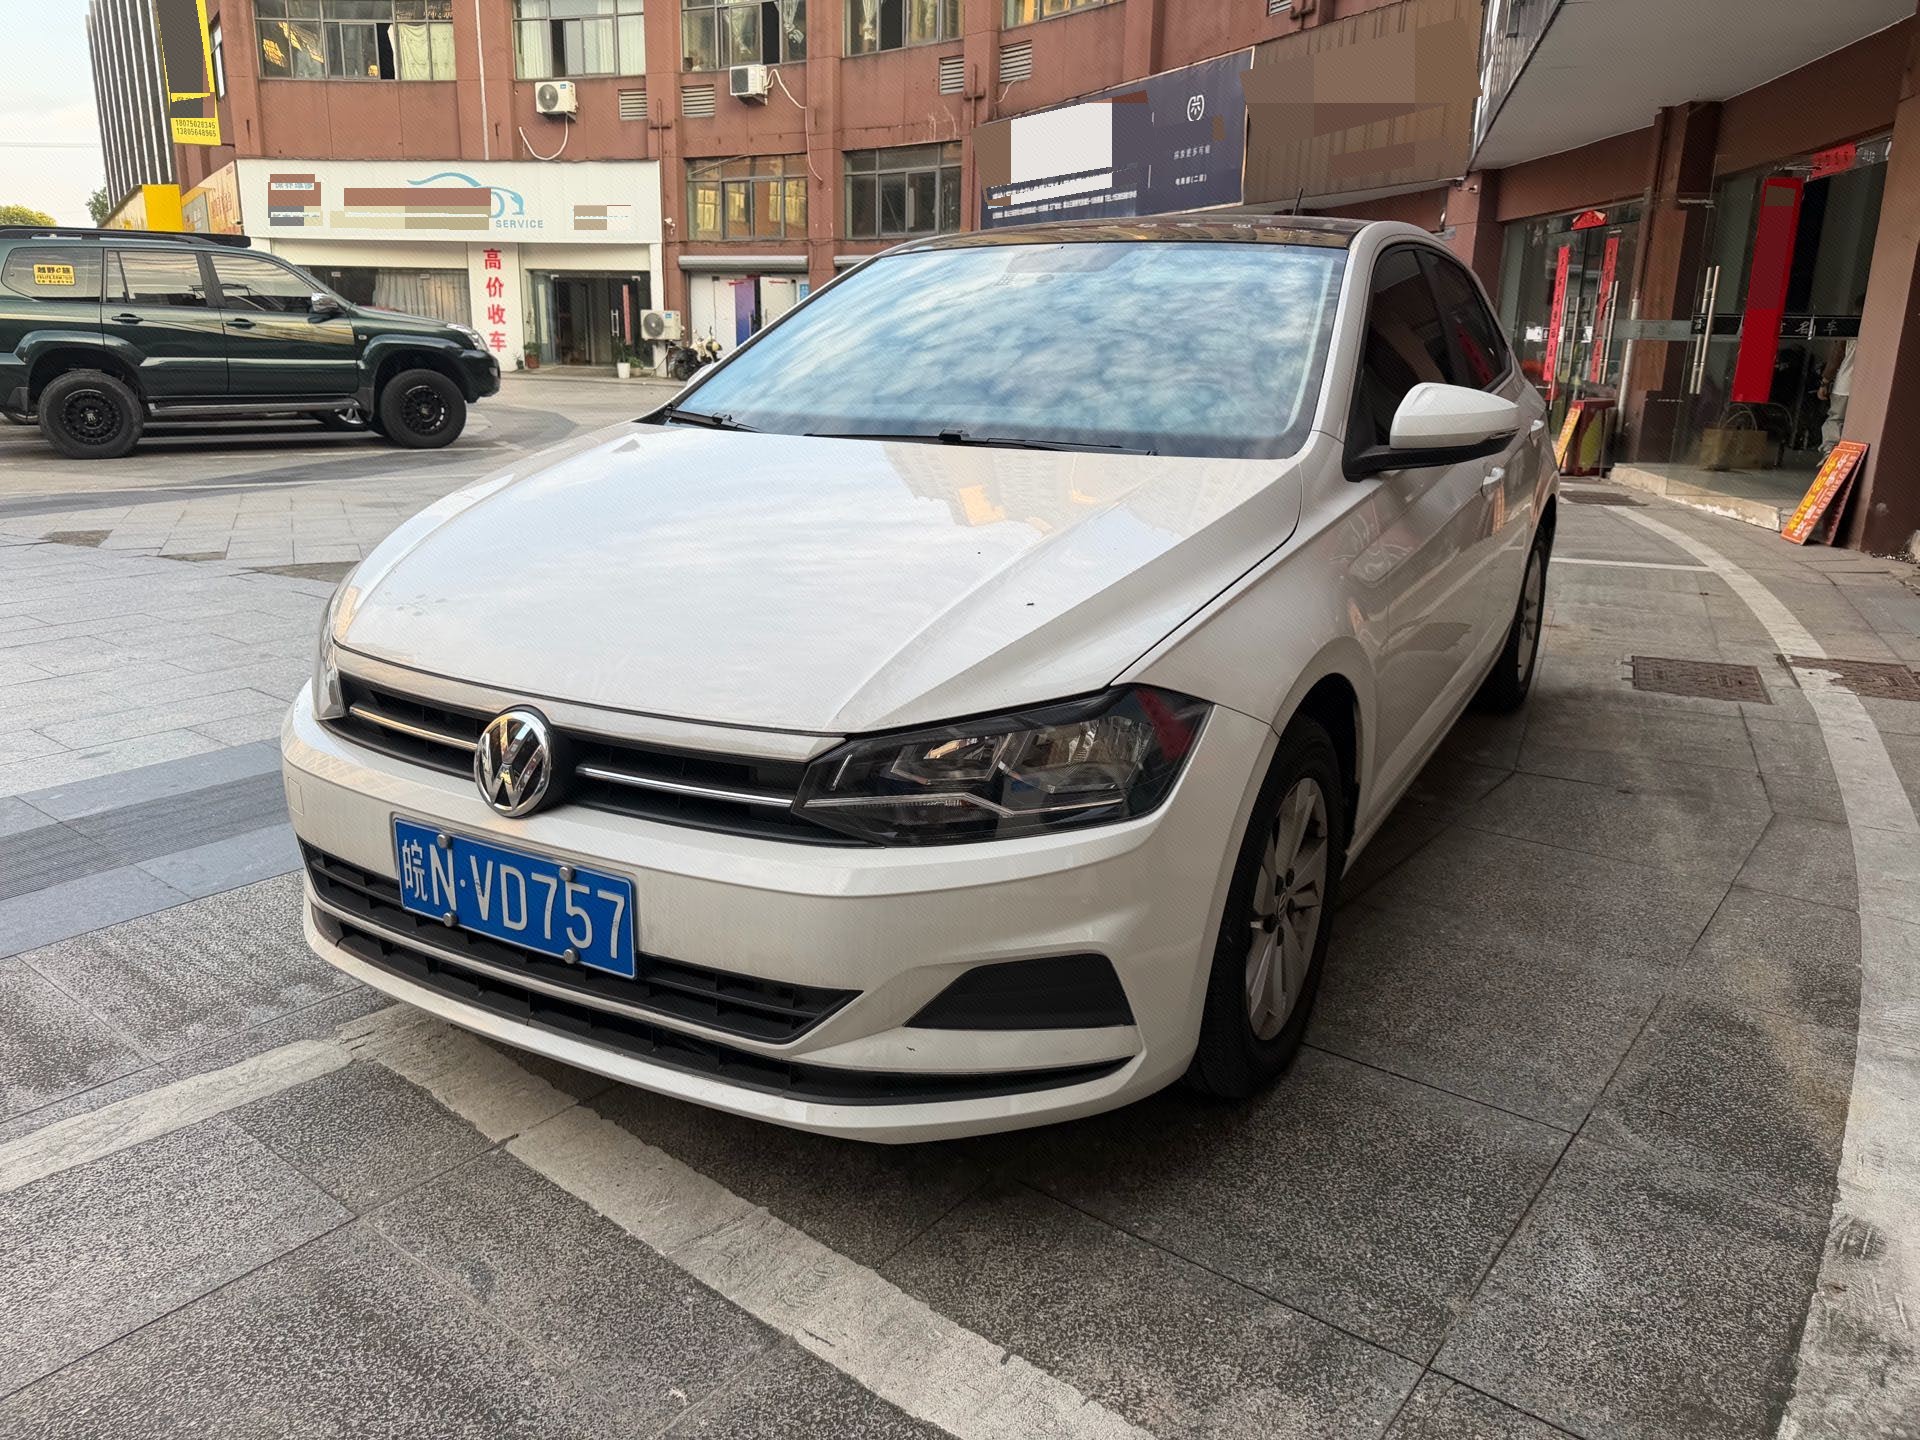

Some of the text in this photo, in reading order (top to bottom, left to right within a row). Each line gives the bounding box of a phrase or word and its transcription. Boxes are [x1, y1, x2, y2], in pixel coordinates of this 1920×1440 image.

[495, 219, 544, 229] SERVICE
[482, 247, 507, 352] 高价收车
[402, 839, 625, 960] 皖N·VD757
